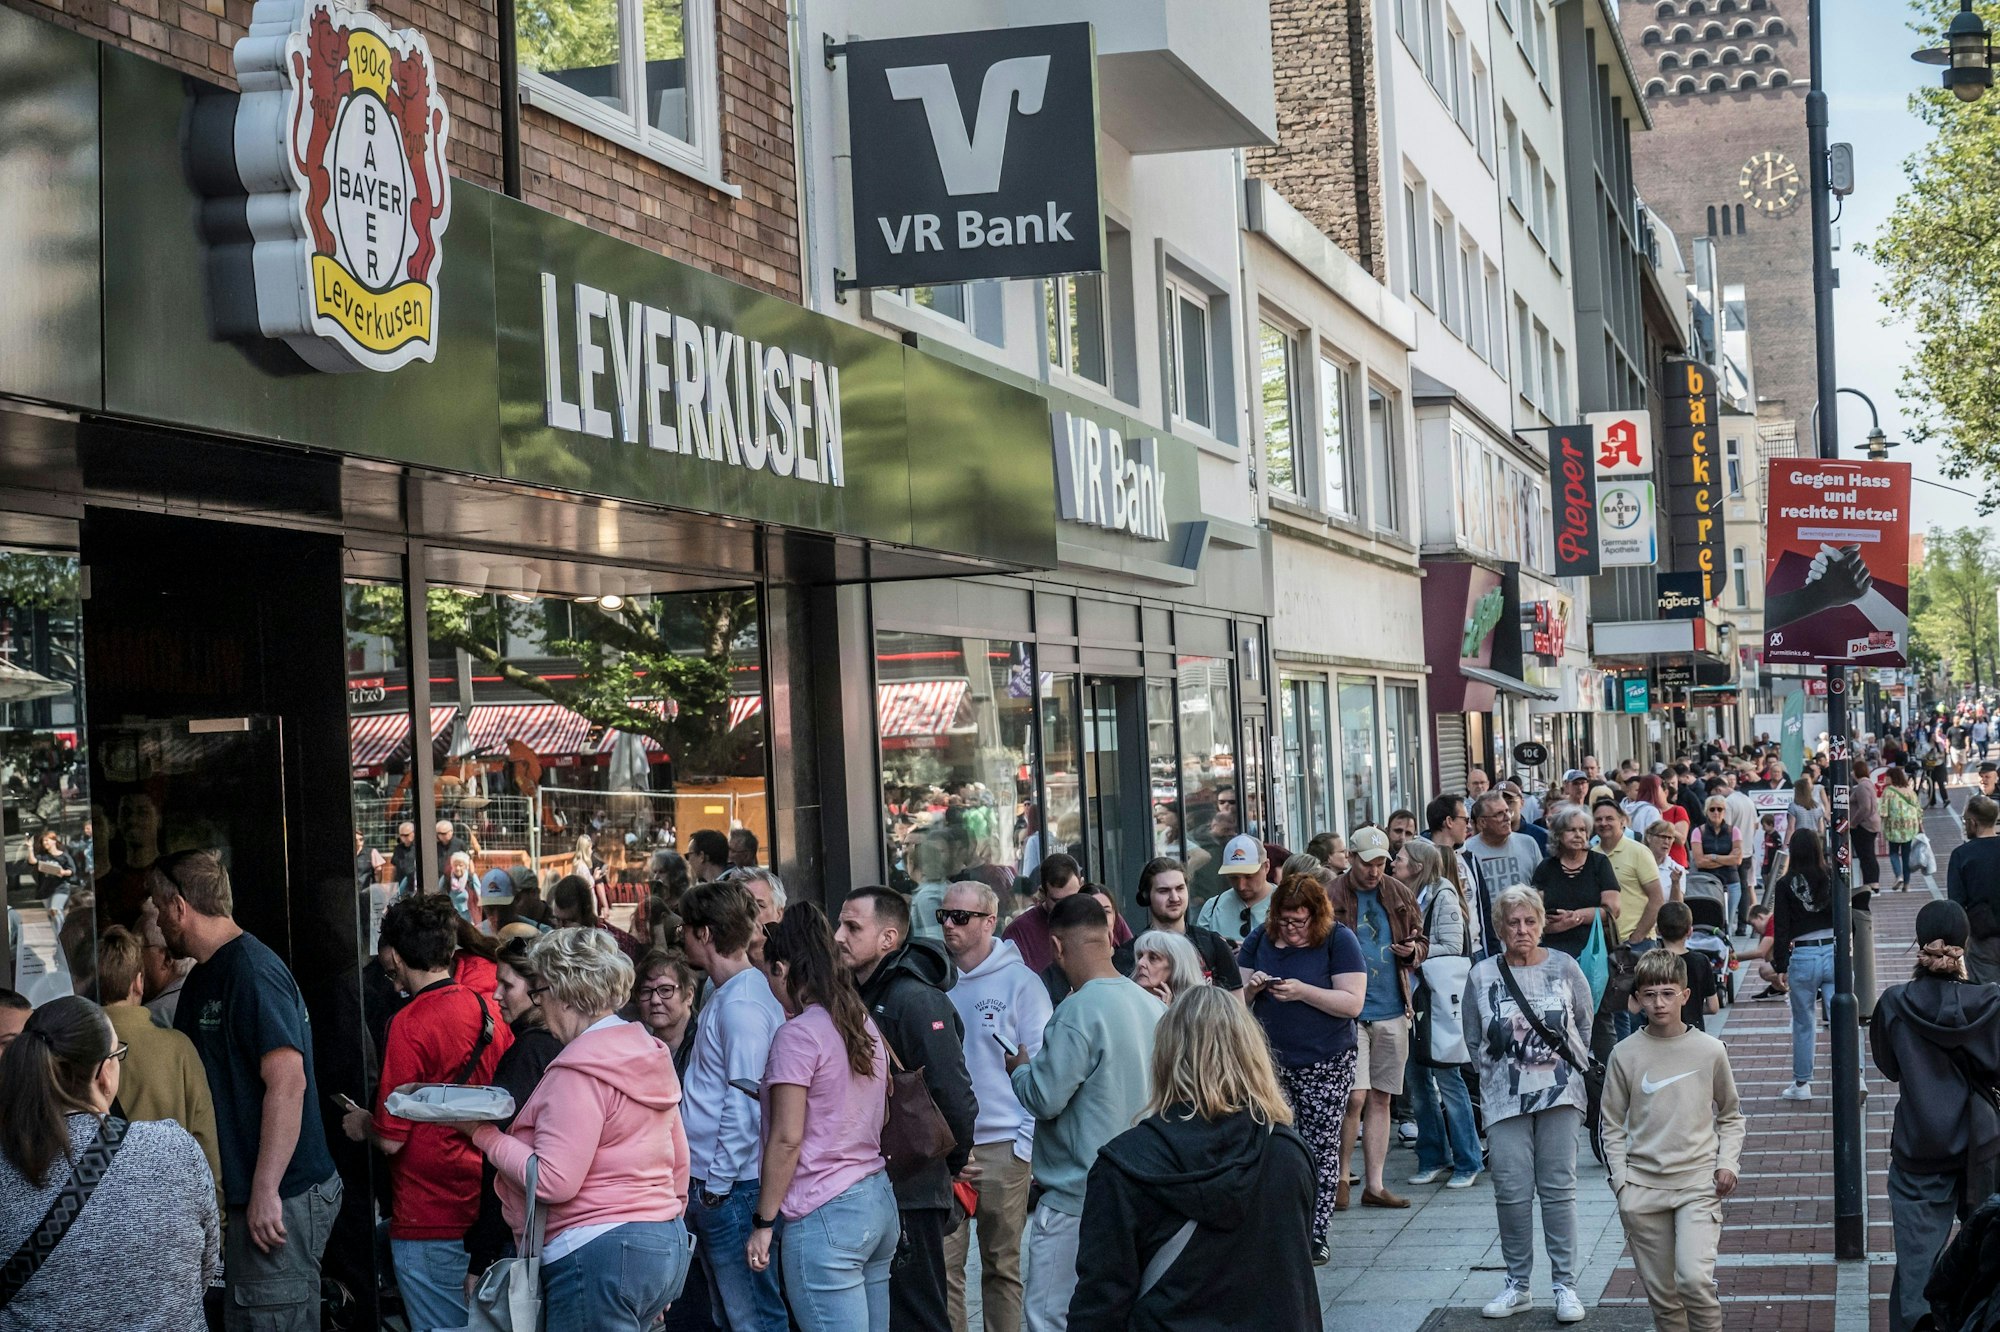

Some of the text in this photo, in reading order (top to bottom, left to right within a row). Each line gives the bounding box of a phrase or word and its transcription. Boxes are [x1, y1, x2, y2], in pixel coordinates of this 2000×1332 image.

[354, 46, 386, 84] 1904
[339, 167, 402, 216] BAYER
[364, 104, 379, 280] BAYER
[877, 201, 1075, 254] VR Bank
[322, 265, 423, 340] Leverkusen
[541, 272, 845, 487] LEVERKUSEN
[1058, 411, 1170, 542] VR Bank
[1790, 471, 1891, 489] Gegen Hass
[1557, 437, 1592, 563] Pieper
[1604, 505, 1637, 513] BAYER
[1823, 489, 1857, 503] und
[1780, 505, 1897, 521] rechte Hetze!
[1605, 546, 1640, 554] Apotheke
[1851, 643, 1868, 653] Die
[974, 999, 1006, 1011] HILFIGER
[990, 1005, 1001, 1013] YORK
